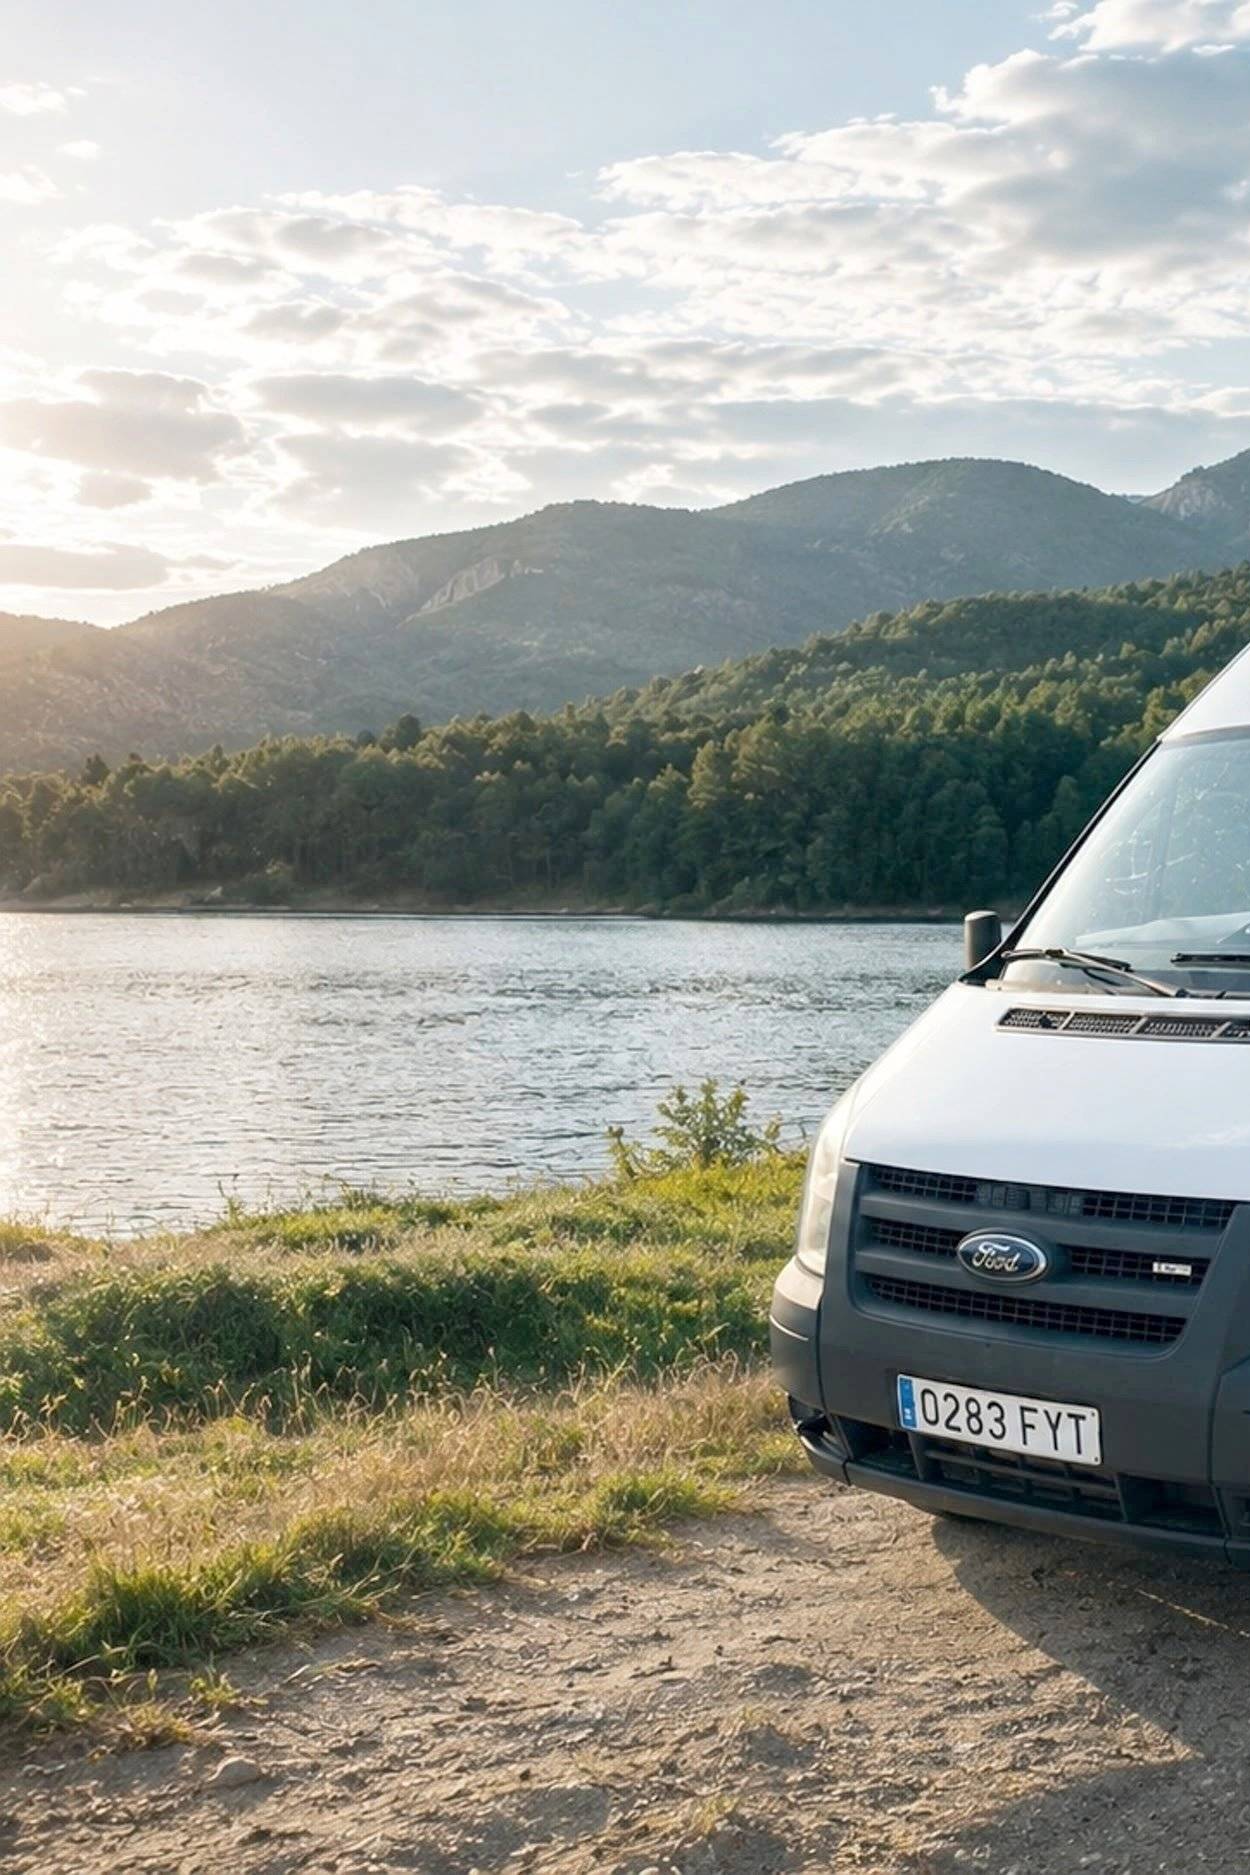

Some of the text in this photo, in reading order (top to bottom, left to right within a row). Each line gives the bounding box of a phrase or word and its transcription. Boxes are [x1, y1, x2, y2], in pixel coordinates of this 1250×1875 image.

[972, 1241, 1020, 1272] Ford
[921, 1388, 1087, 1455] 0283 FYT
